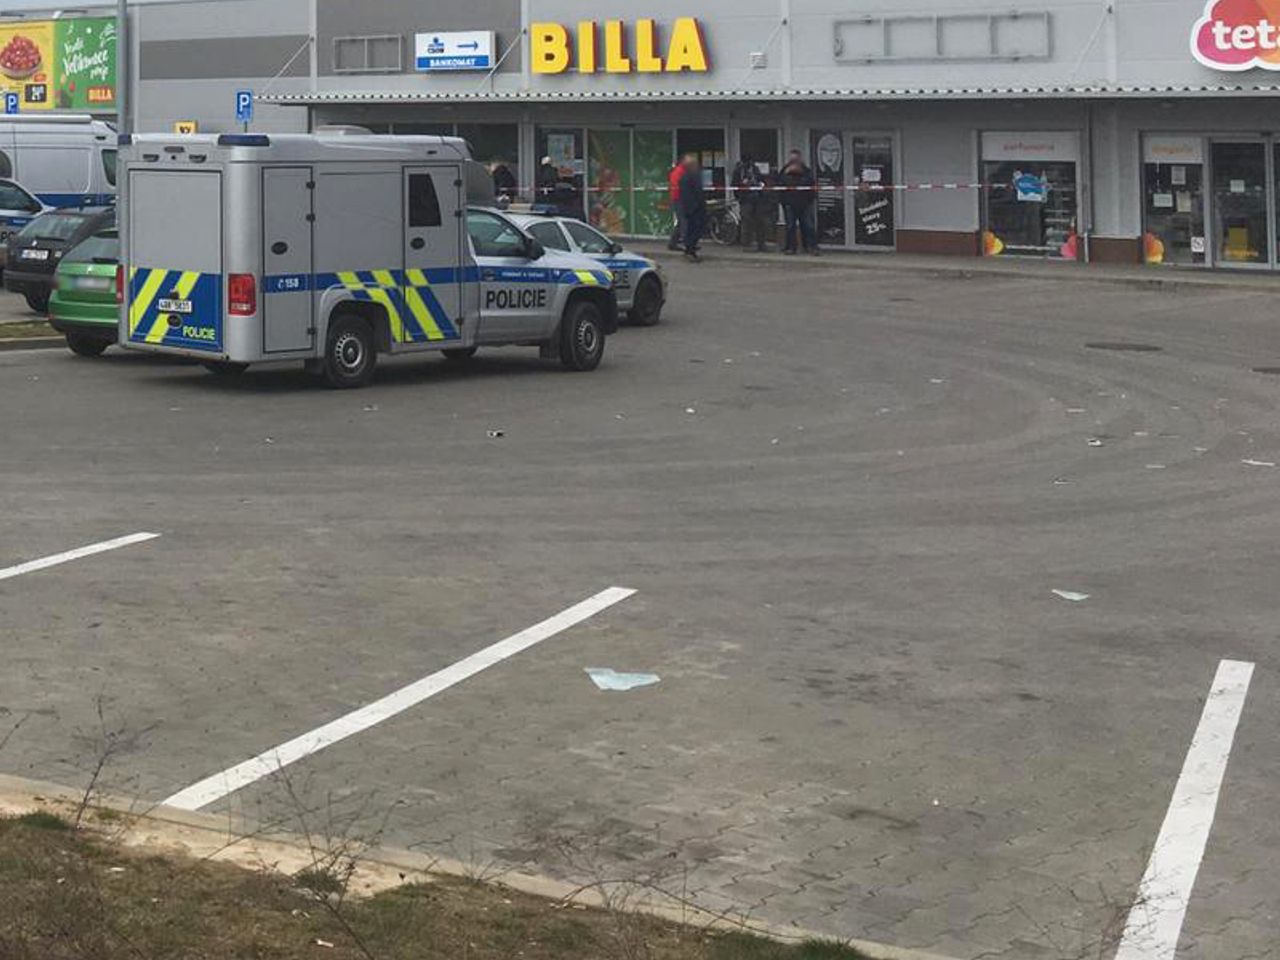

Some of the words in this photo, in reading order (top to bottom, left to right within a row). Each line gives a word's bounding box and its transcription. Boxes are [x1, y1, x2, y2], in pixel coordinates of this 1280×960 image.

[1211, 19, 1280, 50] tet
[530, 17, 710, 74] BILLA
[430, 58, 476, 67] BANKOMAT
[7, 95, 17, 111] P
[239, 94, 250, 113] P
[486, 289, 546, 309] POLICIE
[183, 326, 216, 341] POLICIE
